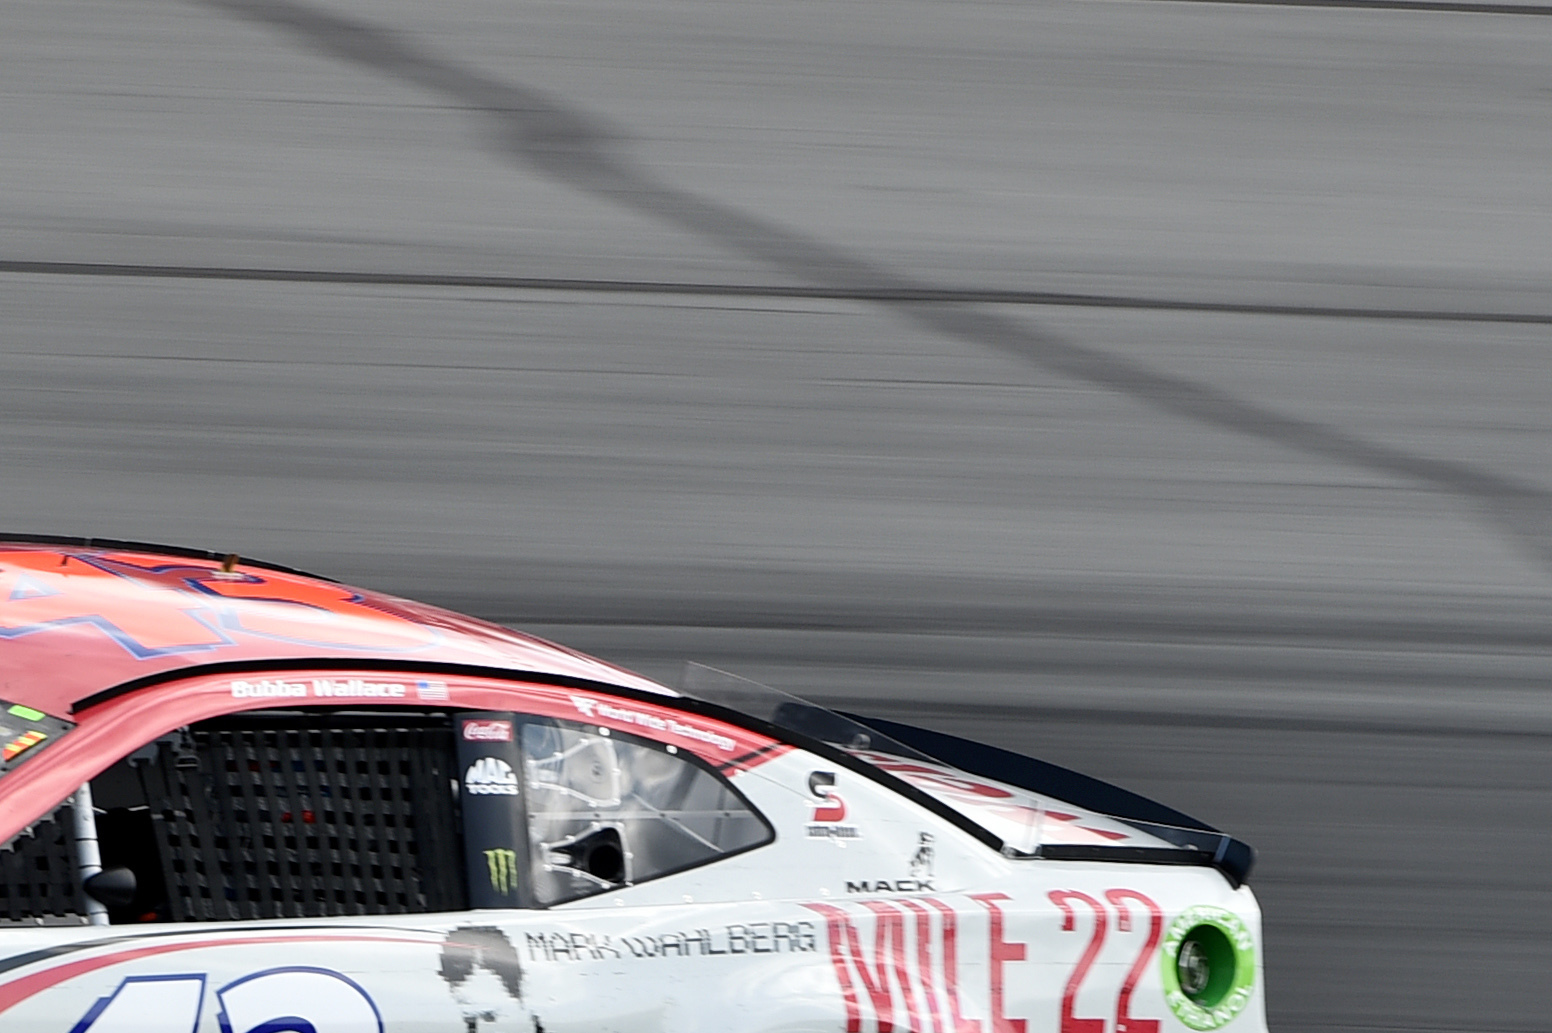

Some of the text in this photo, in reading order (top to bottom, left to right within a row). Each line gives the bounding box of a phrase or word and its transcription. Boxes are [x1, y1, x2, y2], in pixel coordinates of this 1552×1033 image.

[230, 679, 406, 698] Bubba Wallace
[465, 757, 517, 783] MAC
[846, 880, 936, 893] MACK
[524, 920, 817, 962] MARK WAHLBERG
